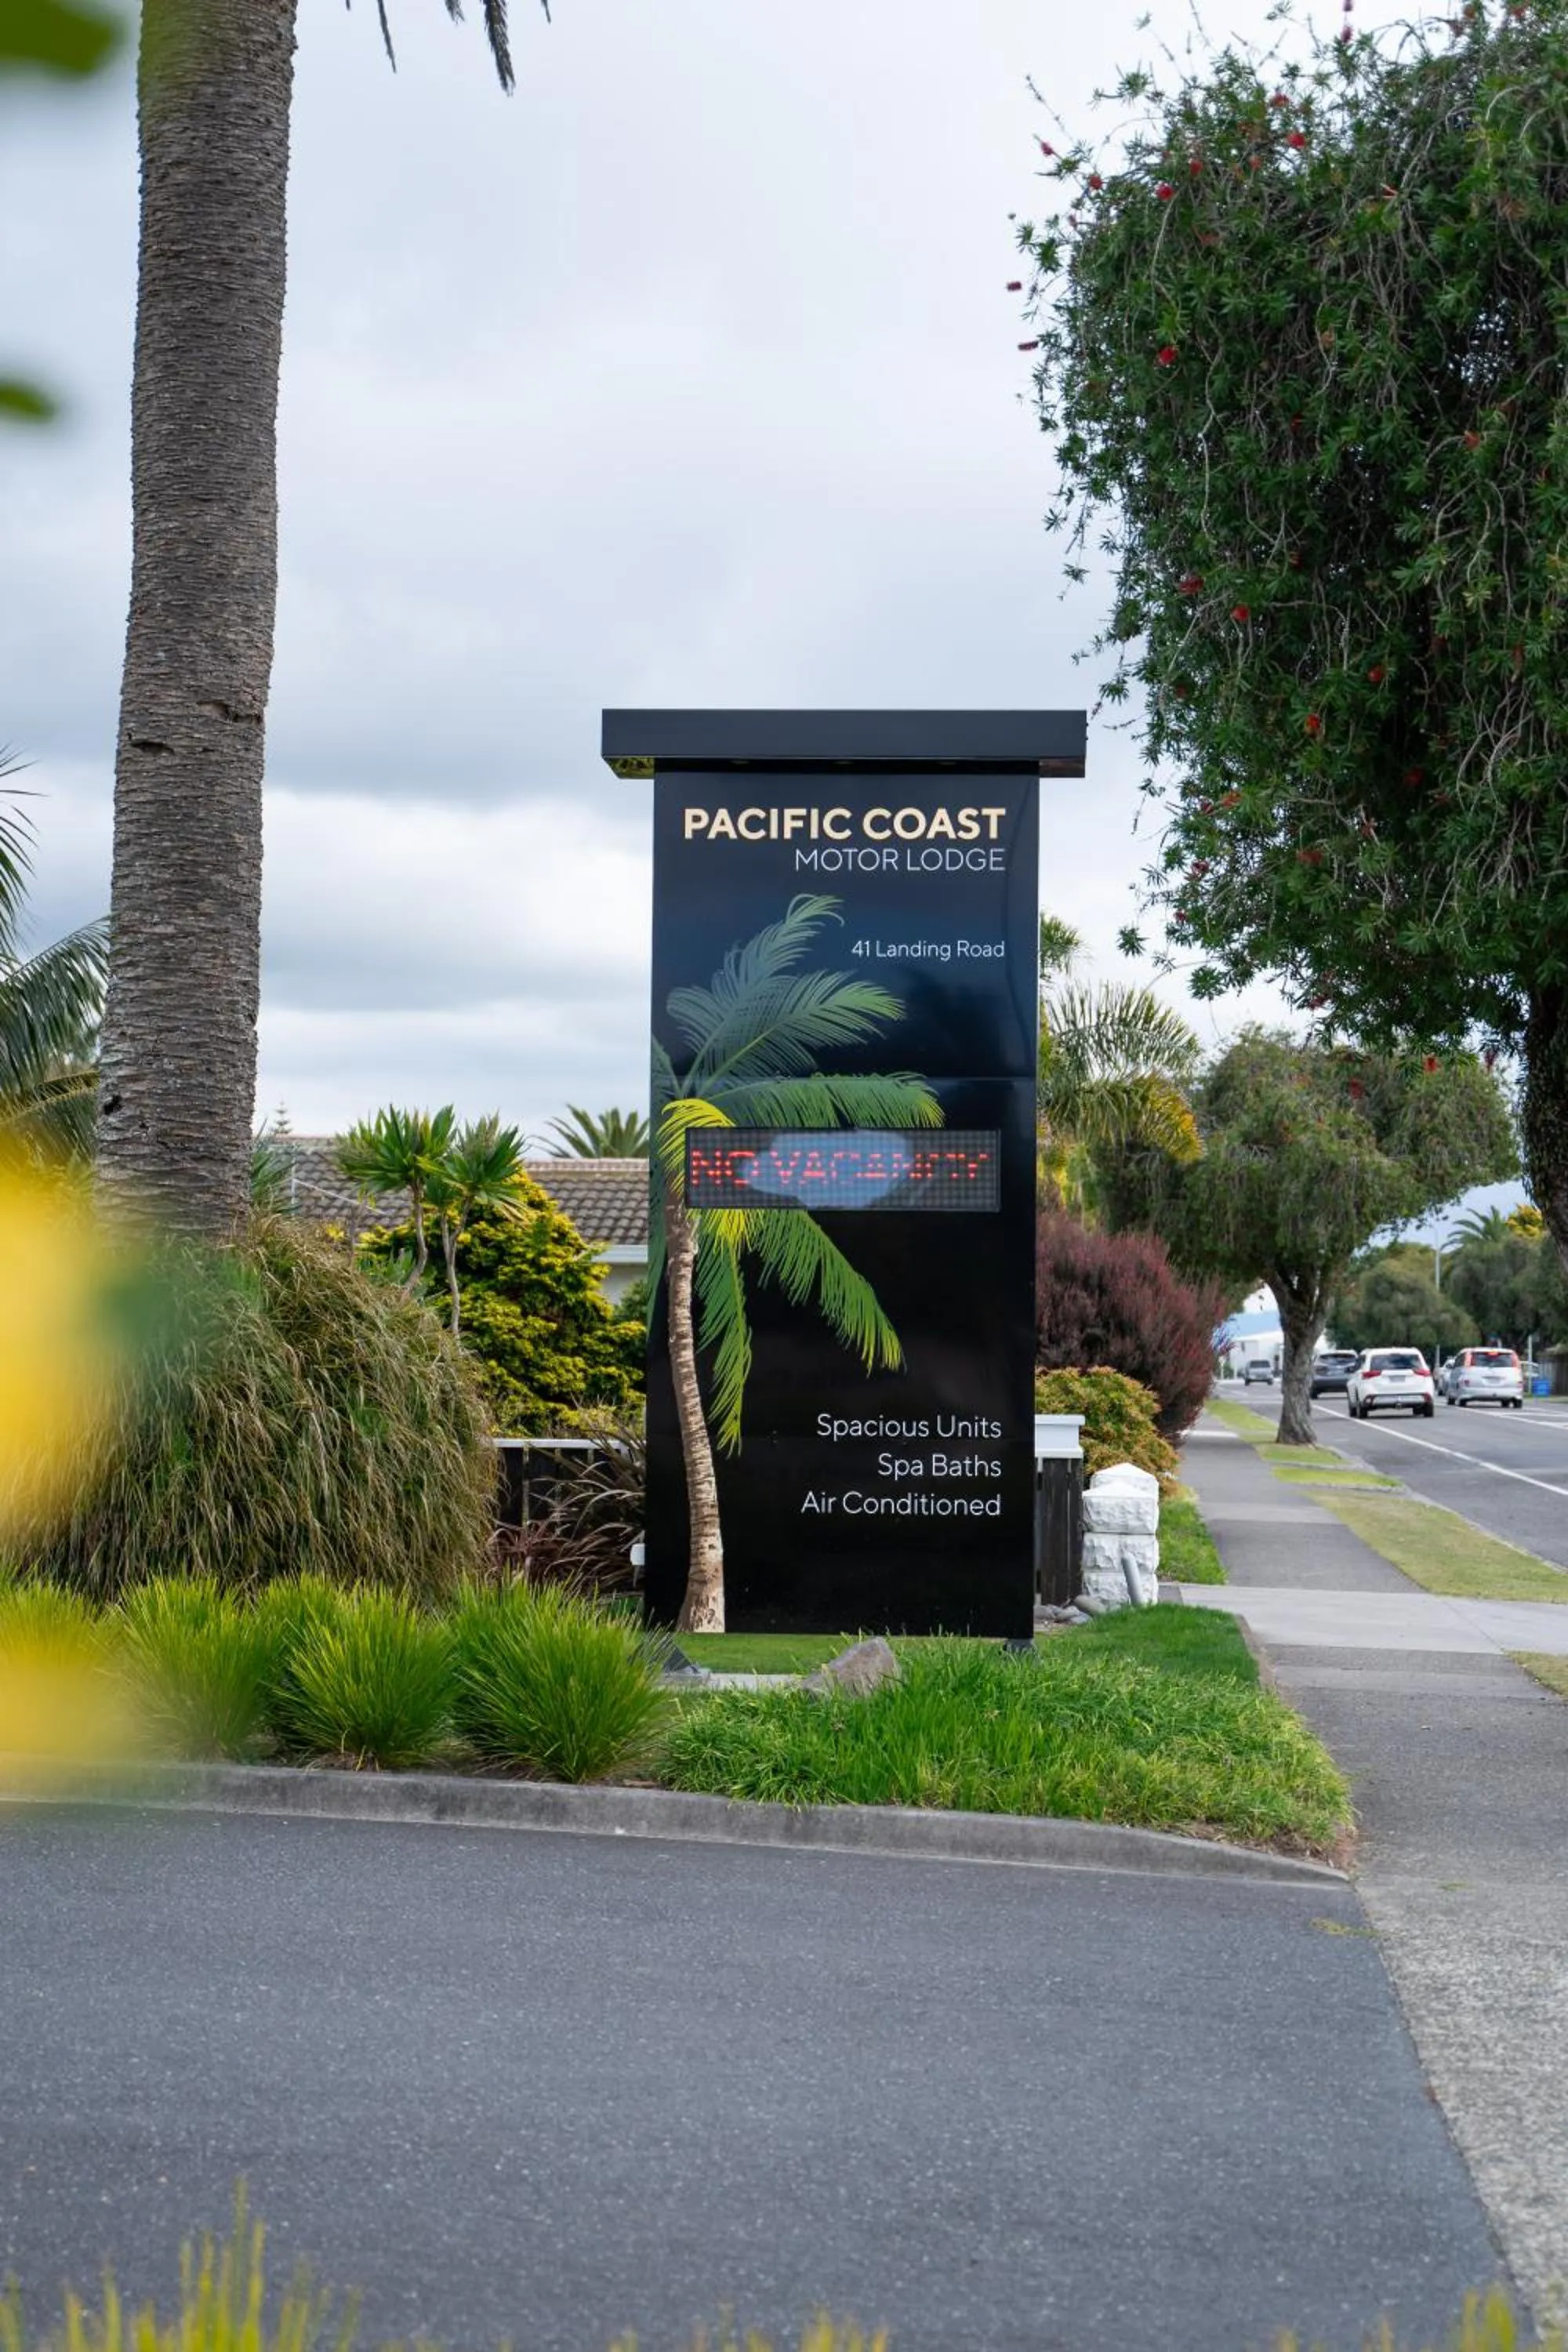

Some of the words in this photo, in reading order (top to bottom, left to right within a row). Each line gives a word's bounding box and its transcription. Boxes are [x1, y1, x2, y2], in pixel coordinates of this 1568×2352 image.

[684, 808, 852, 840] PACIFIC
[862, 808, 1006, 840] COAST
[796, 848, 898, 871] MOTOR
[907, 848, 1006, 871] LODGE
[851, 941, 870, 957] 41
[876, 940, 951, 961] Landing
[957, 940, 1004, 958] Road
[690, 1149, 760, 1188] NO
[816, 1414, 929, 1442] Spacious
[936, 1415, 1002, 1439] Units
[877, 1453, 924, 1480] Spa
[931, 1454, 1002, 1477] Baths
[801, 1490, 837, 1514] Air
[842, 1490, 1001, 1515] Conditioned
